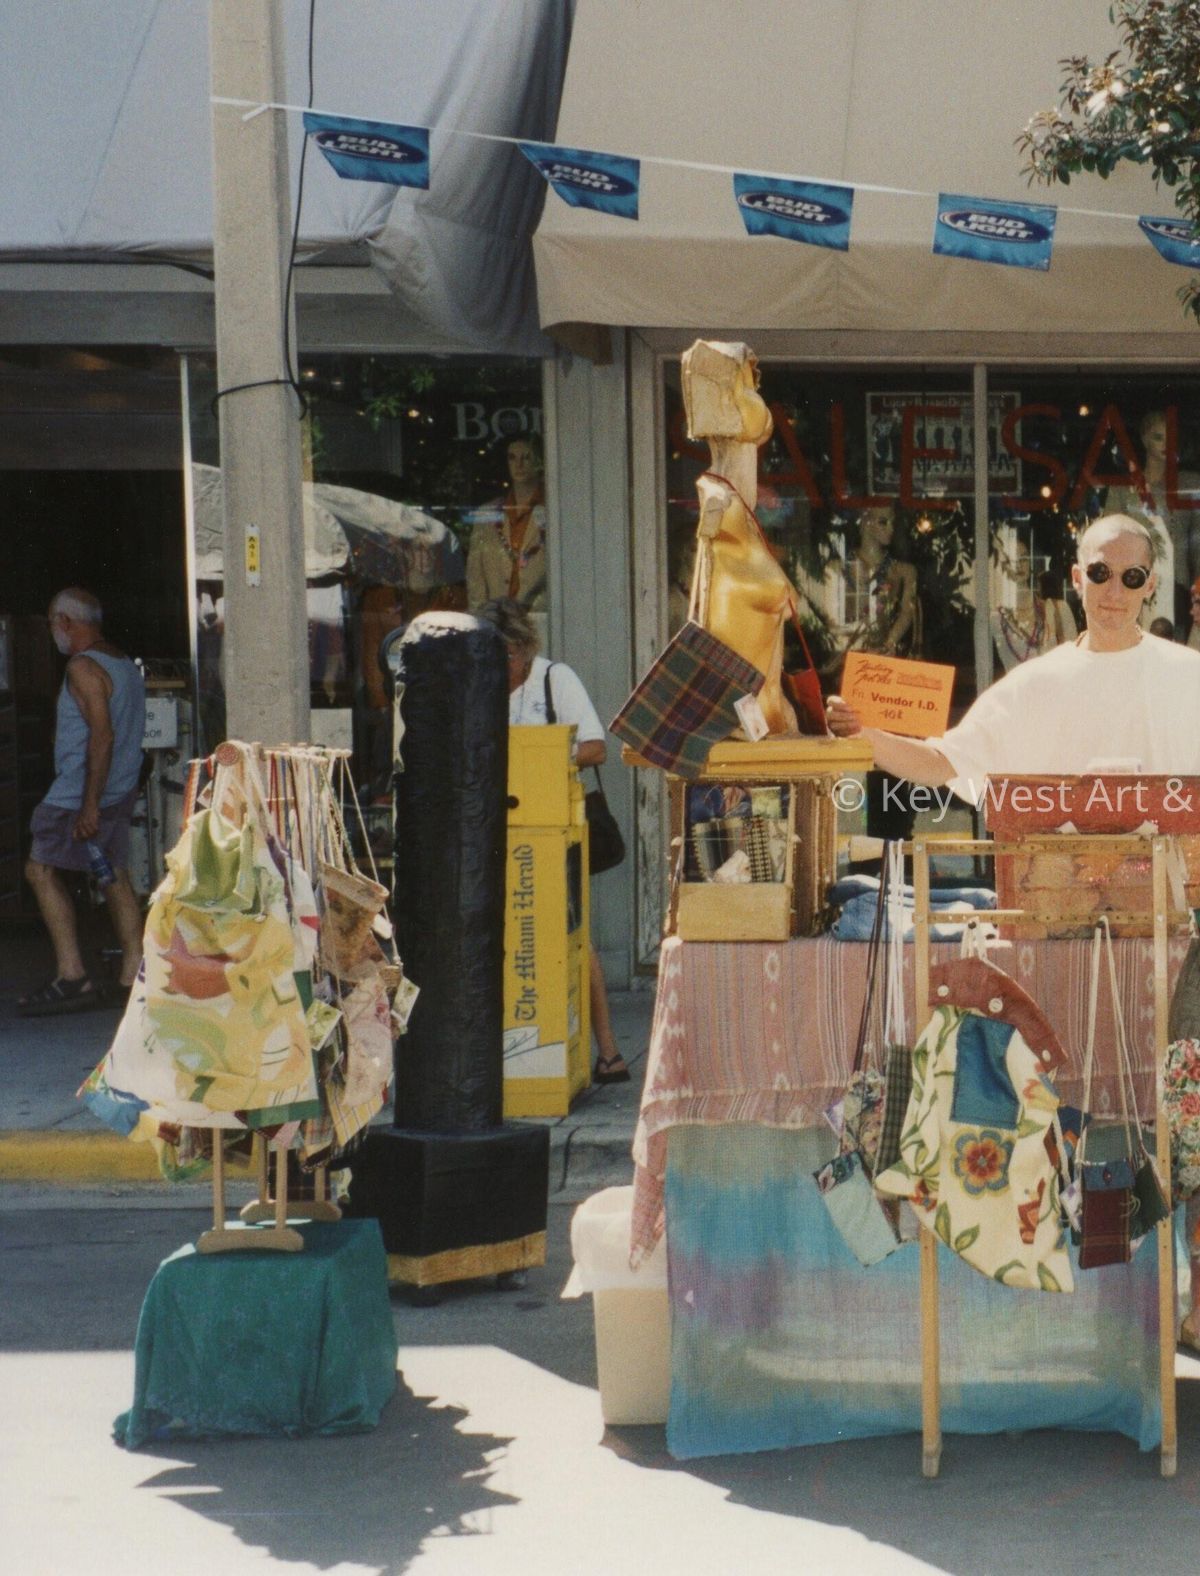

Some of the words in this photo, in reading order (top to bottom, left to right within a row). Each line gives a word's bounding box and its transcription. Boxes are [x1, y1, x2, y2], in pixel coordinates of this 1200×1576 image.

[324, 140, 408, 160] LIGHT
[337, 135, 399, 150] BUD
[551, 164, 610, 183] BUD
[752, 200, 831, 222] LIGHT
[765, 195, 823, 213] BUD
[956, 219, 1034, 239] LIGHT
[968, 213, 1026, 229] BUD
[871, 692, 914, 708] Vendor
[917, 700, 939, 712] I.D.
[512, 844, 535, 911] Herald
[514, 914, 537, 982] Miami
[514, 986, 540, 1022] The
